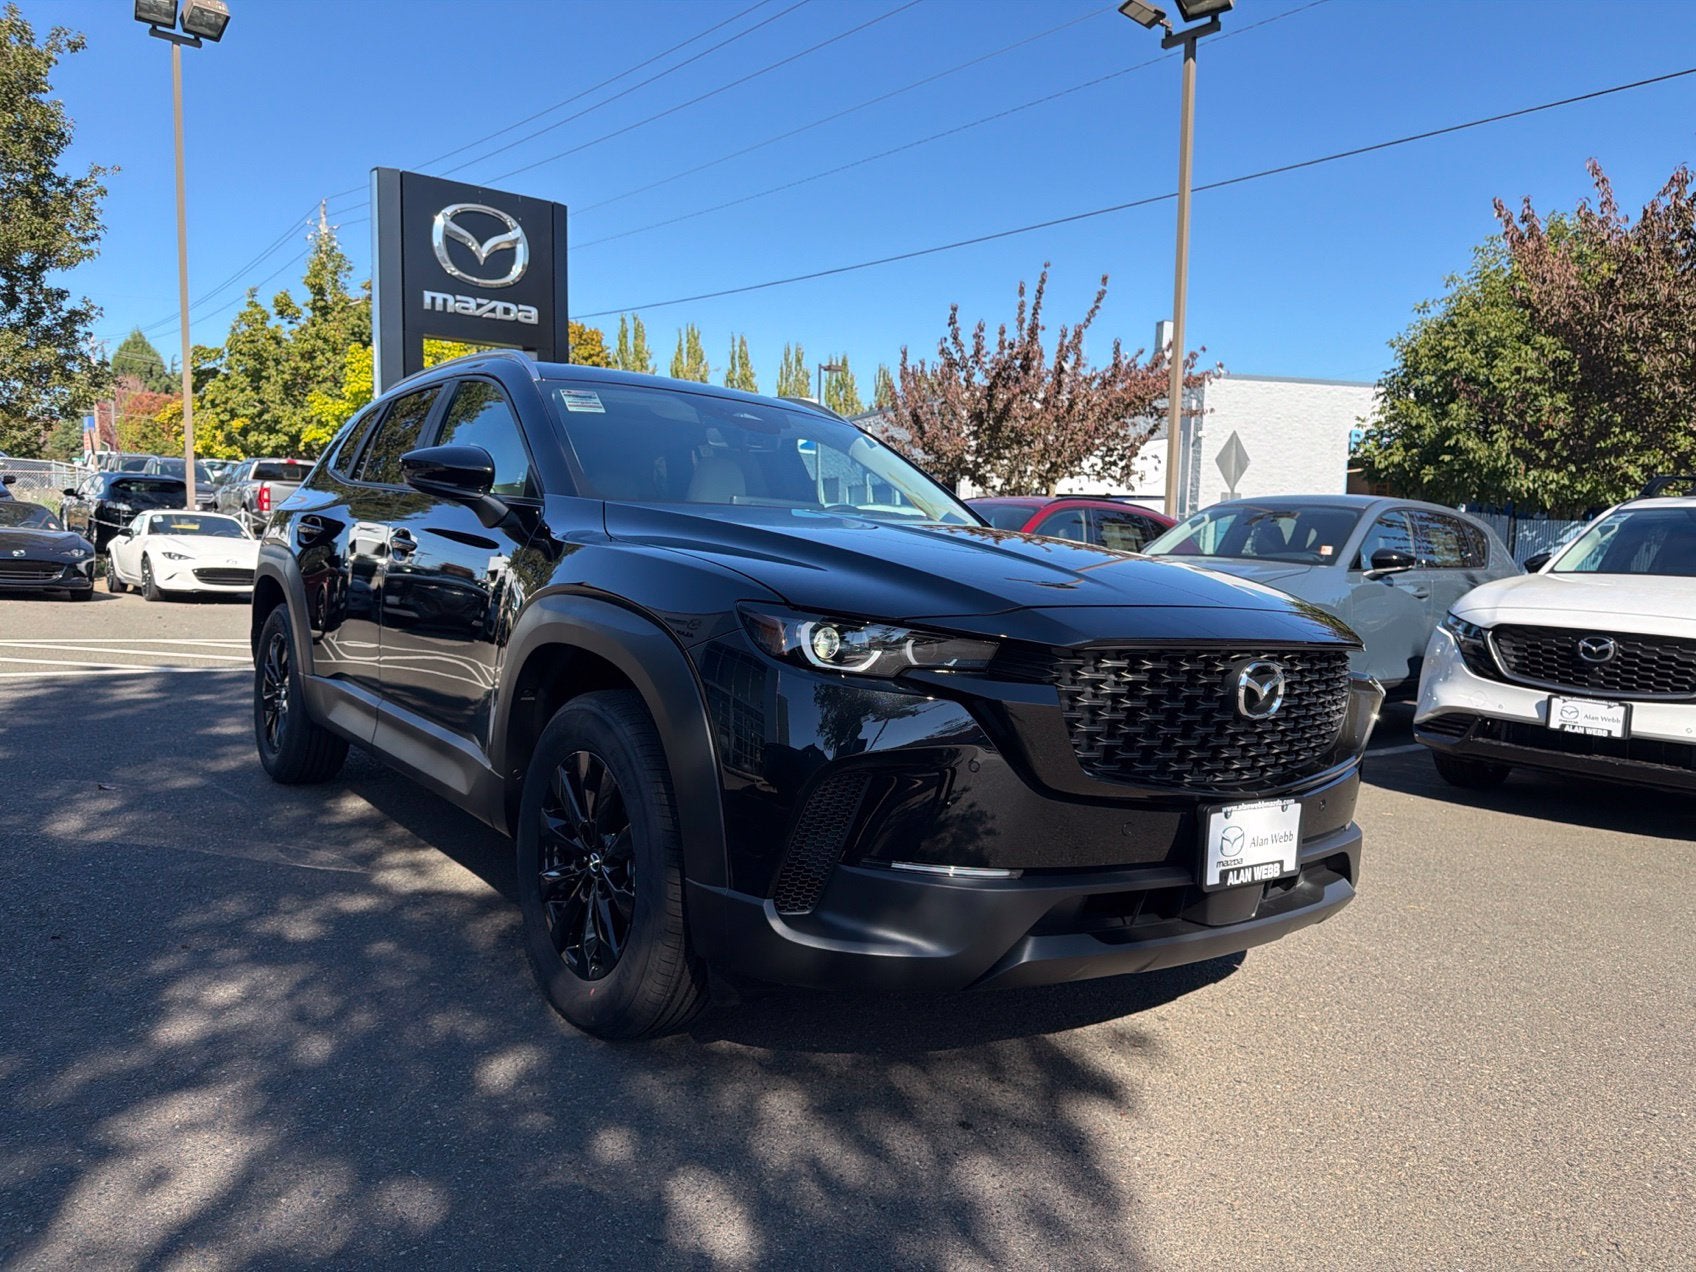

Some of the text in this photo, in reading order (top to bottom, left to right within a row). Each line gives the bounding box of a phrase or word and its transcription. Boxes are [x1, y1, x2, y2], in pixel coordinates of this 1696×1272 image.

[423, 290, 538, 325] mazda
[1600, 715, 1621, 724] Webb
[1564, 724, 1585, 734] ALAN
[1250, 830, 1294, 848] Alan Webb
[1216, 858, 1243, 868] mazda
[1227, 863, 1280, 886] ALAN WEBB
